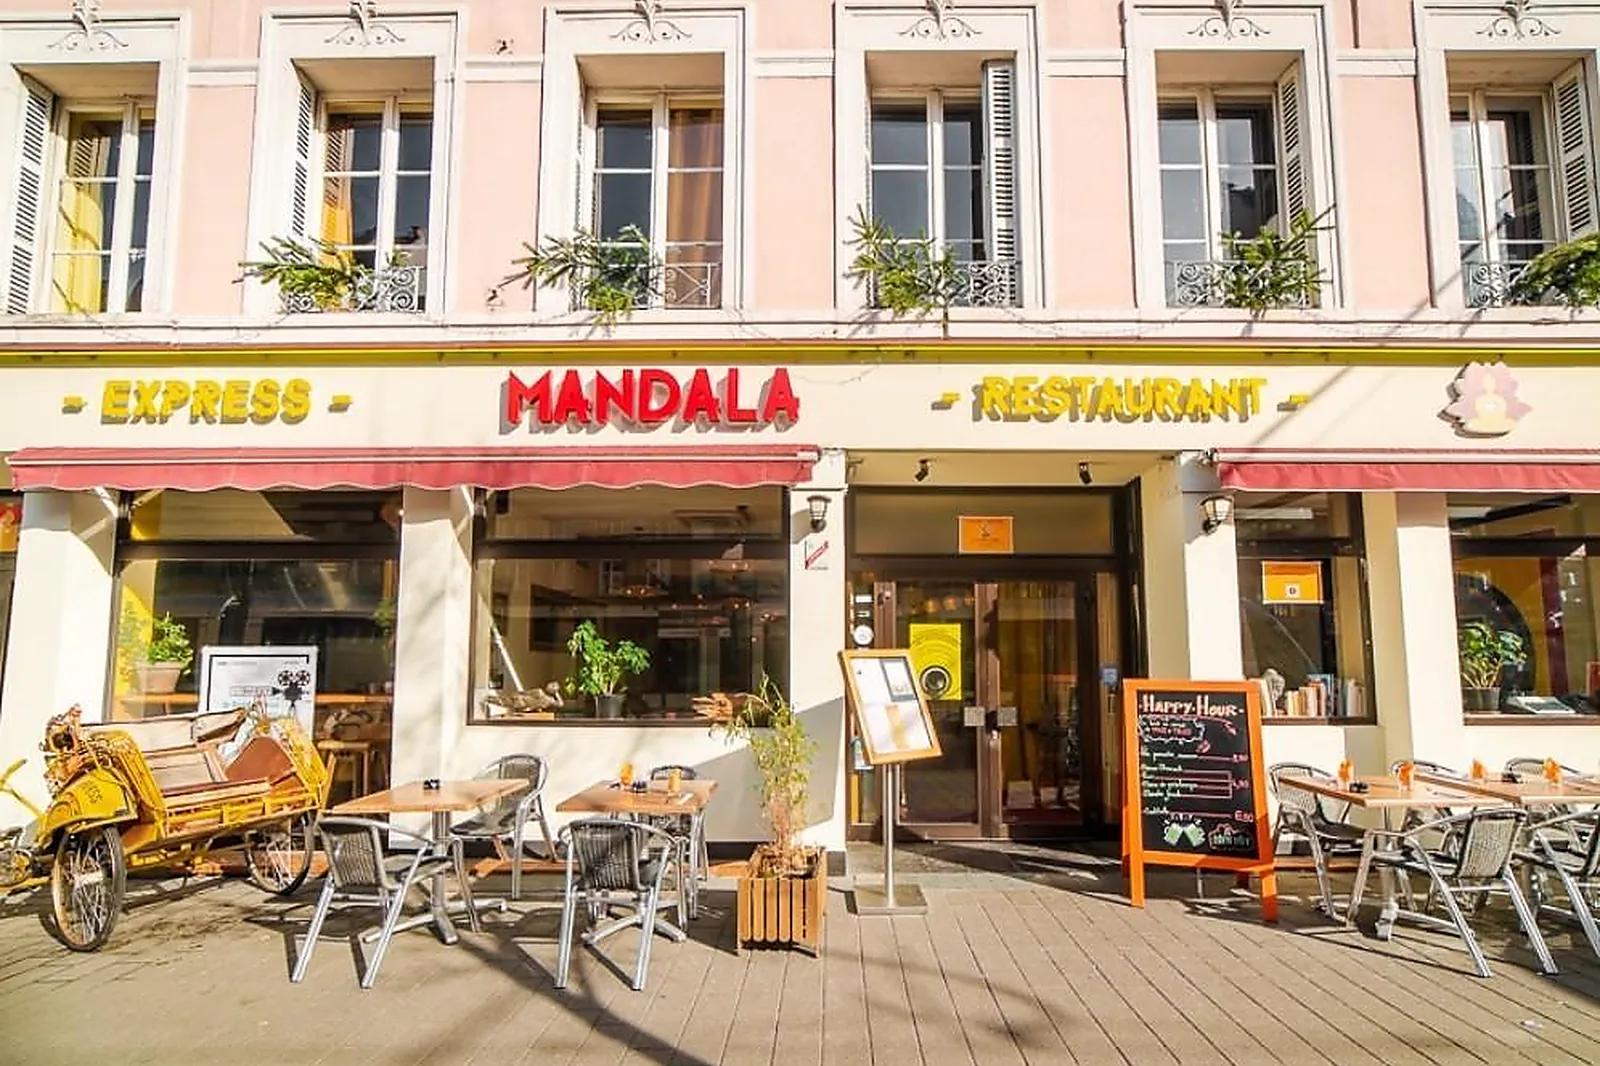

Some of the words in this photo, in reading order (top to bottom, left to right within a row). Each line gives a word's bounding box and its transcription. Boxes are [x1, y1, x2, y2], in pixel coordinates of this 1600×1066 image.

[101, 379, 311, 423] EXPRESS
[505, 367, 800, 424] MANDALA
[977, 375, 1268, 418] RESTAURANT
